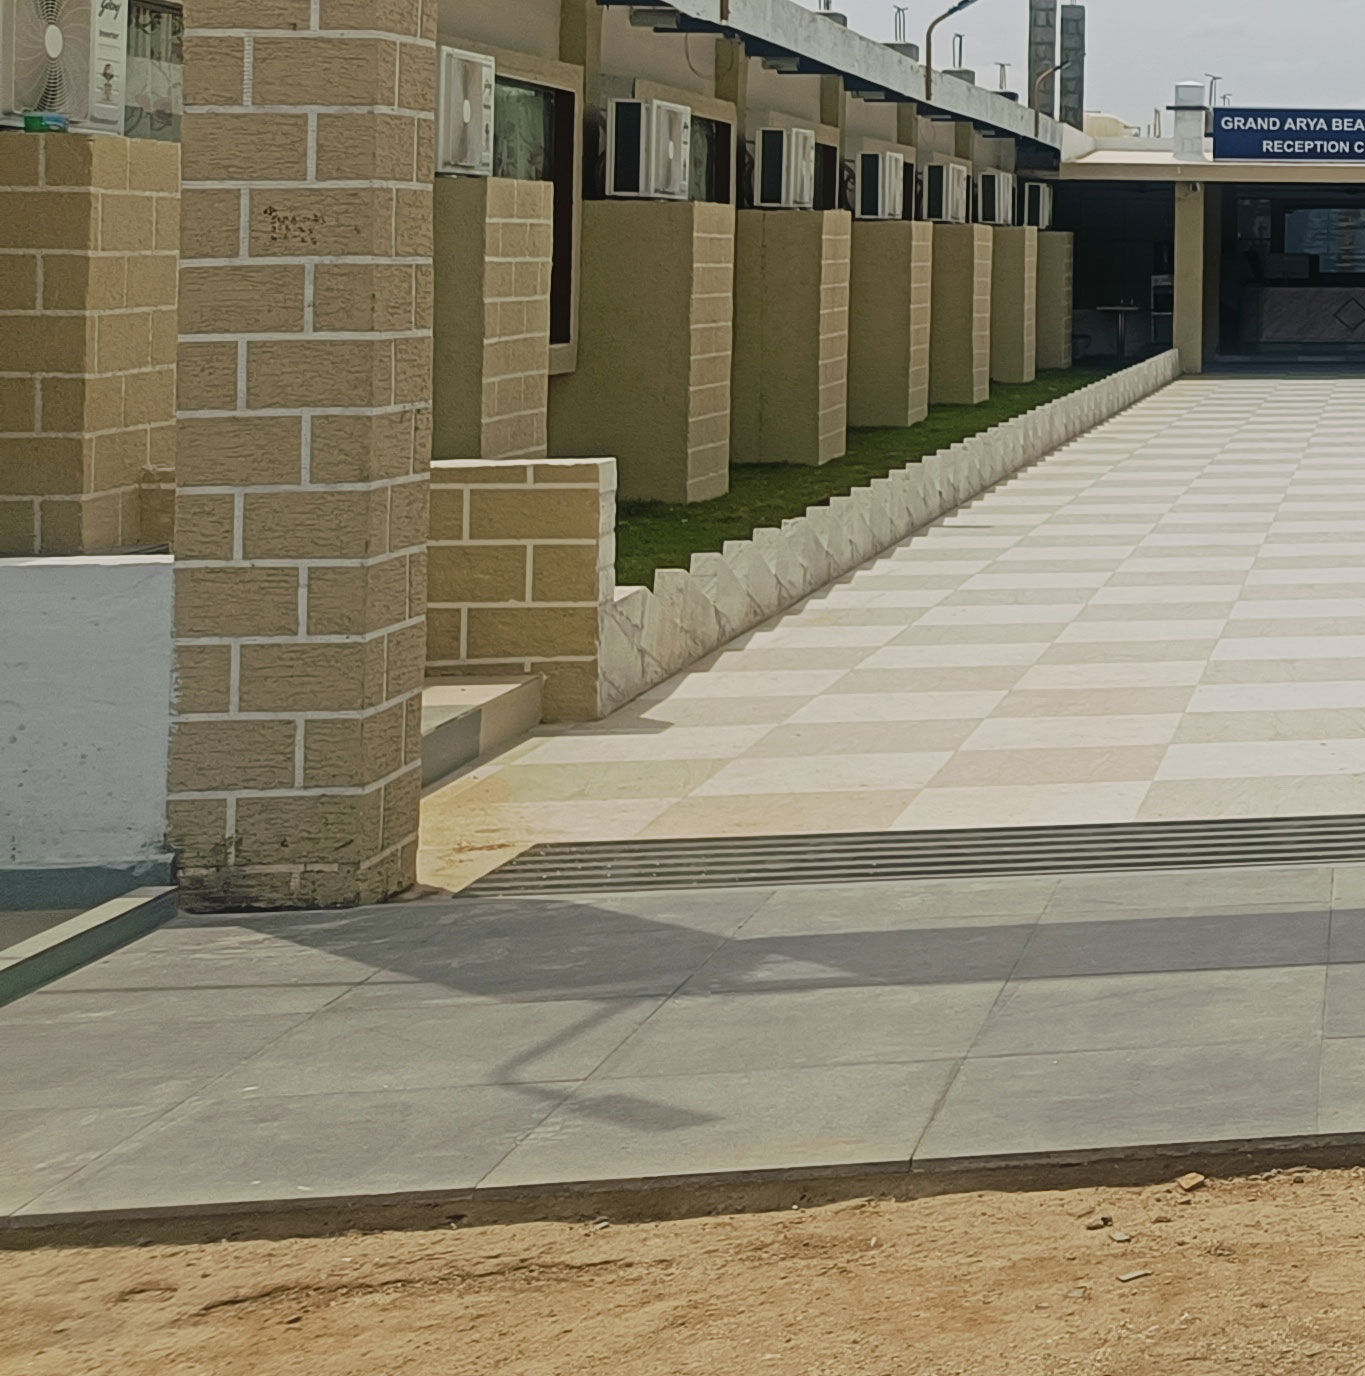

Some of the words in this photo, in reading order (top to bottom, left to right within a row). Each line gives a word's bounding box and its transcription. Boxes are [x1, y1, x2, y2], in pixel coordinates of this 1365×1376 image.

[1221, 117, 1280, 130] GRAND
[1284, 118, 1327, 130] ARYA
[1263, 140, 1349, 152] RECEPTION
